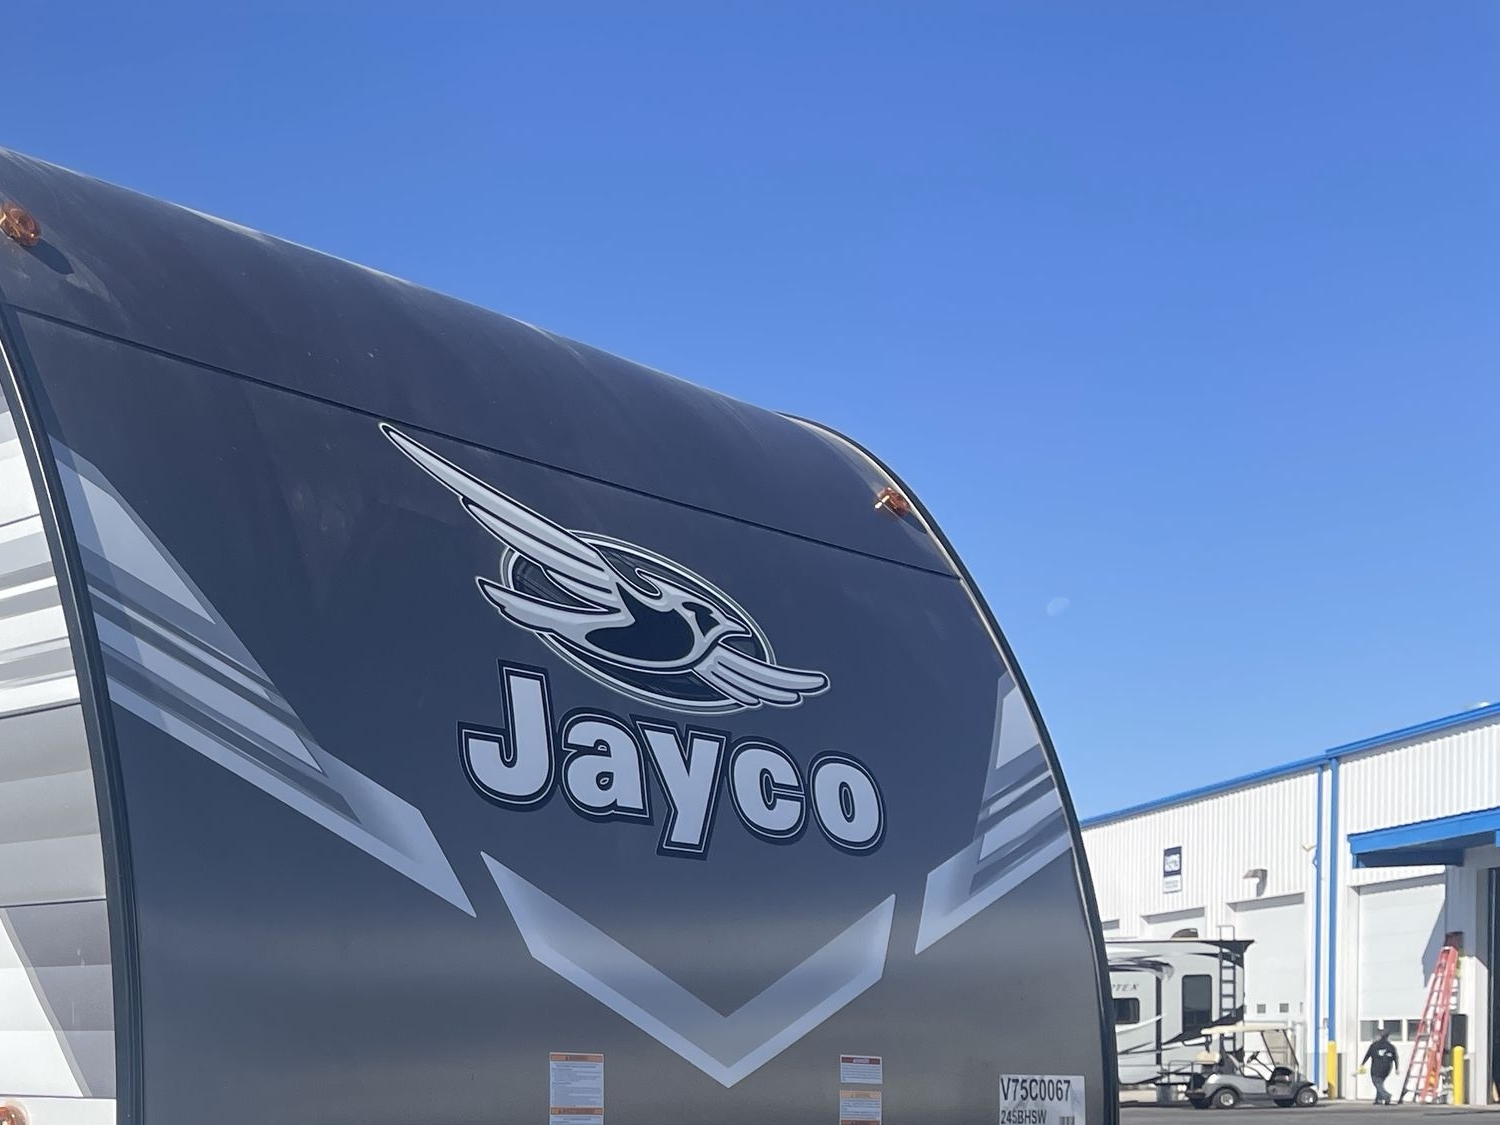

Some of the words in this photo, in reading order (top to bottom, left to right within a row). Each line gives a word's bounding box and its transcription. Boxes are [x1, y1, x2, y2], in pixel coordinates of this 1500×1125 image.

[459, 662, 887, 857] Jayco
[1000, 1077, 1071, 1102] V75C0067
[1000, 1109, 1047, 1125] 245BHSW
